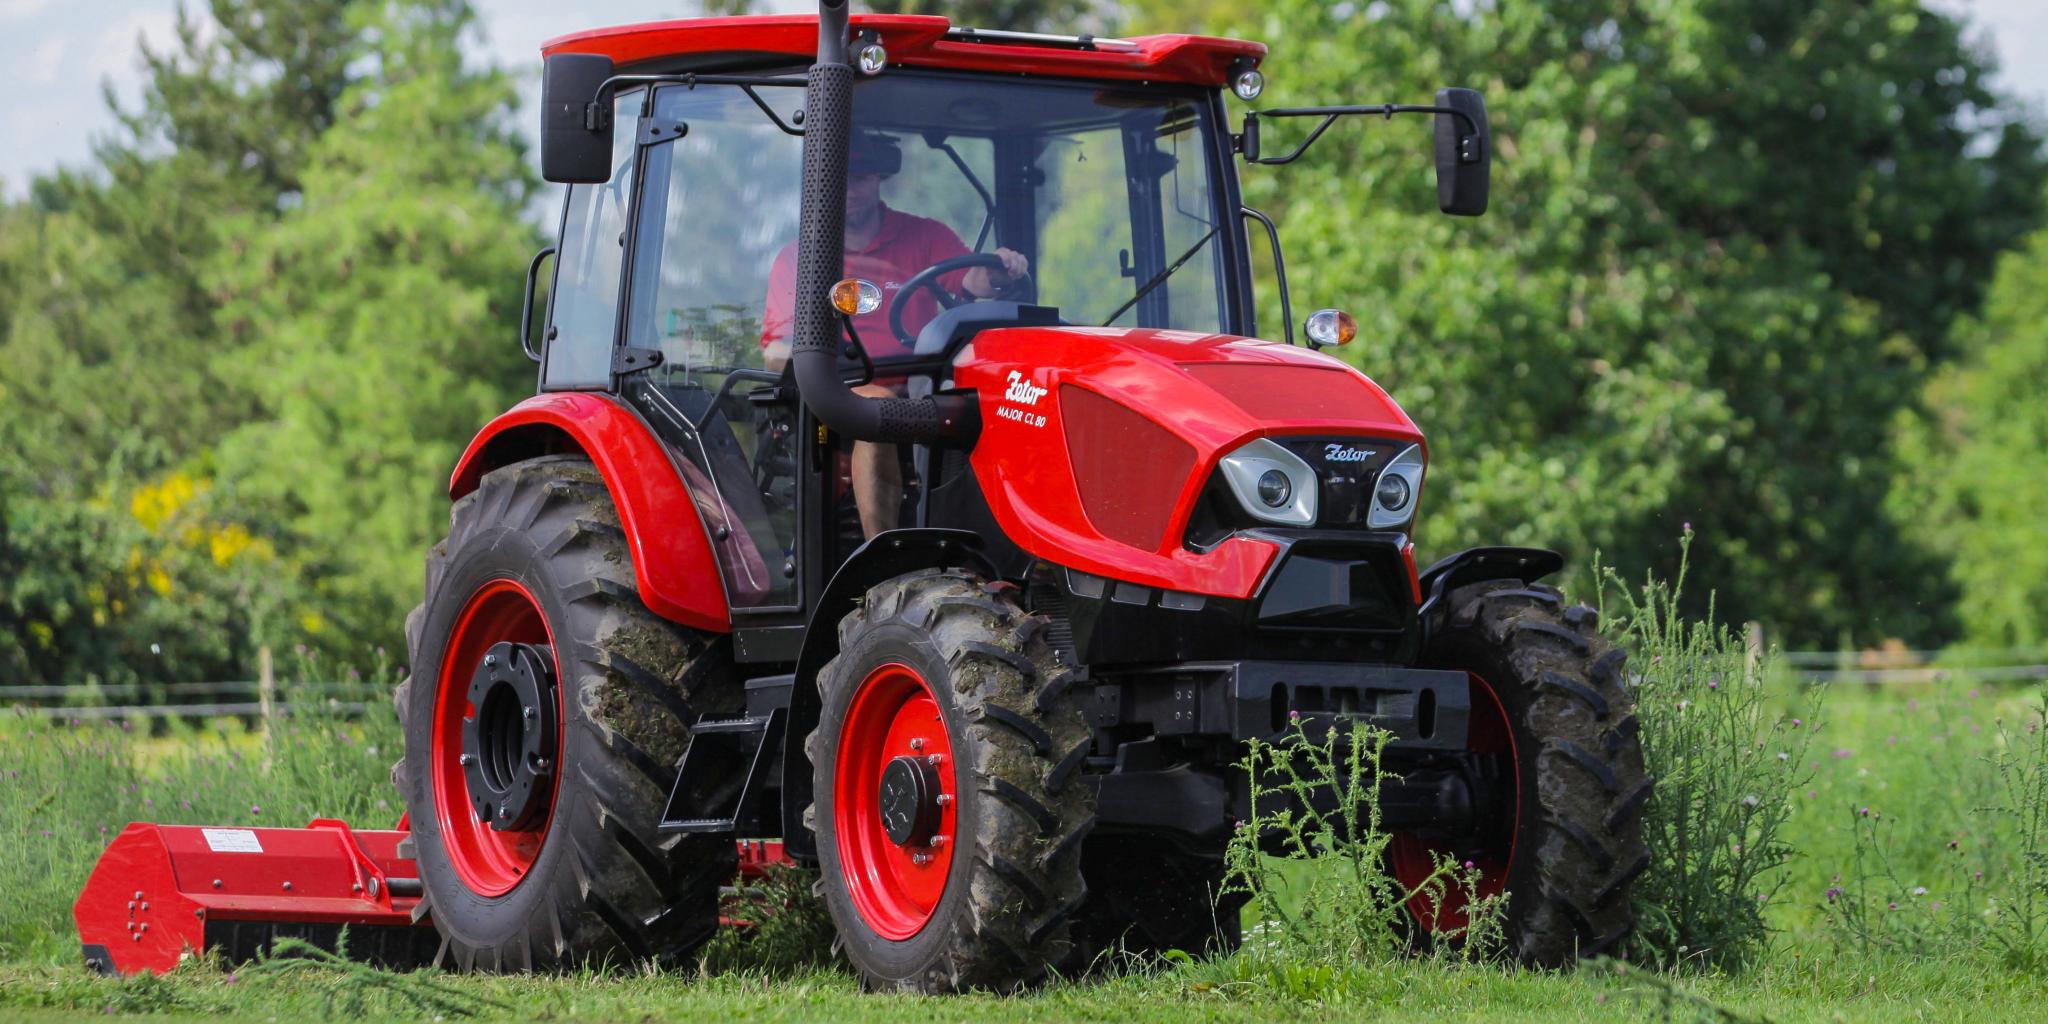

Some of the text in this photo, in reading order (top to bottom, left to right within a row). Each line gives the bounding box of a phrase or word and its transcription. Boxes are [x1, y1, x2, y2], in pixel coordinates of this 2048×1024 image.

[1005, 370, 1047, 405] Zetor
[996, 406, 1046, 427] MAJOR CL 80
[1325, 444, 1376, 461] Zetor
